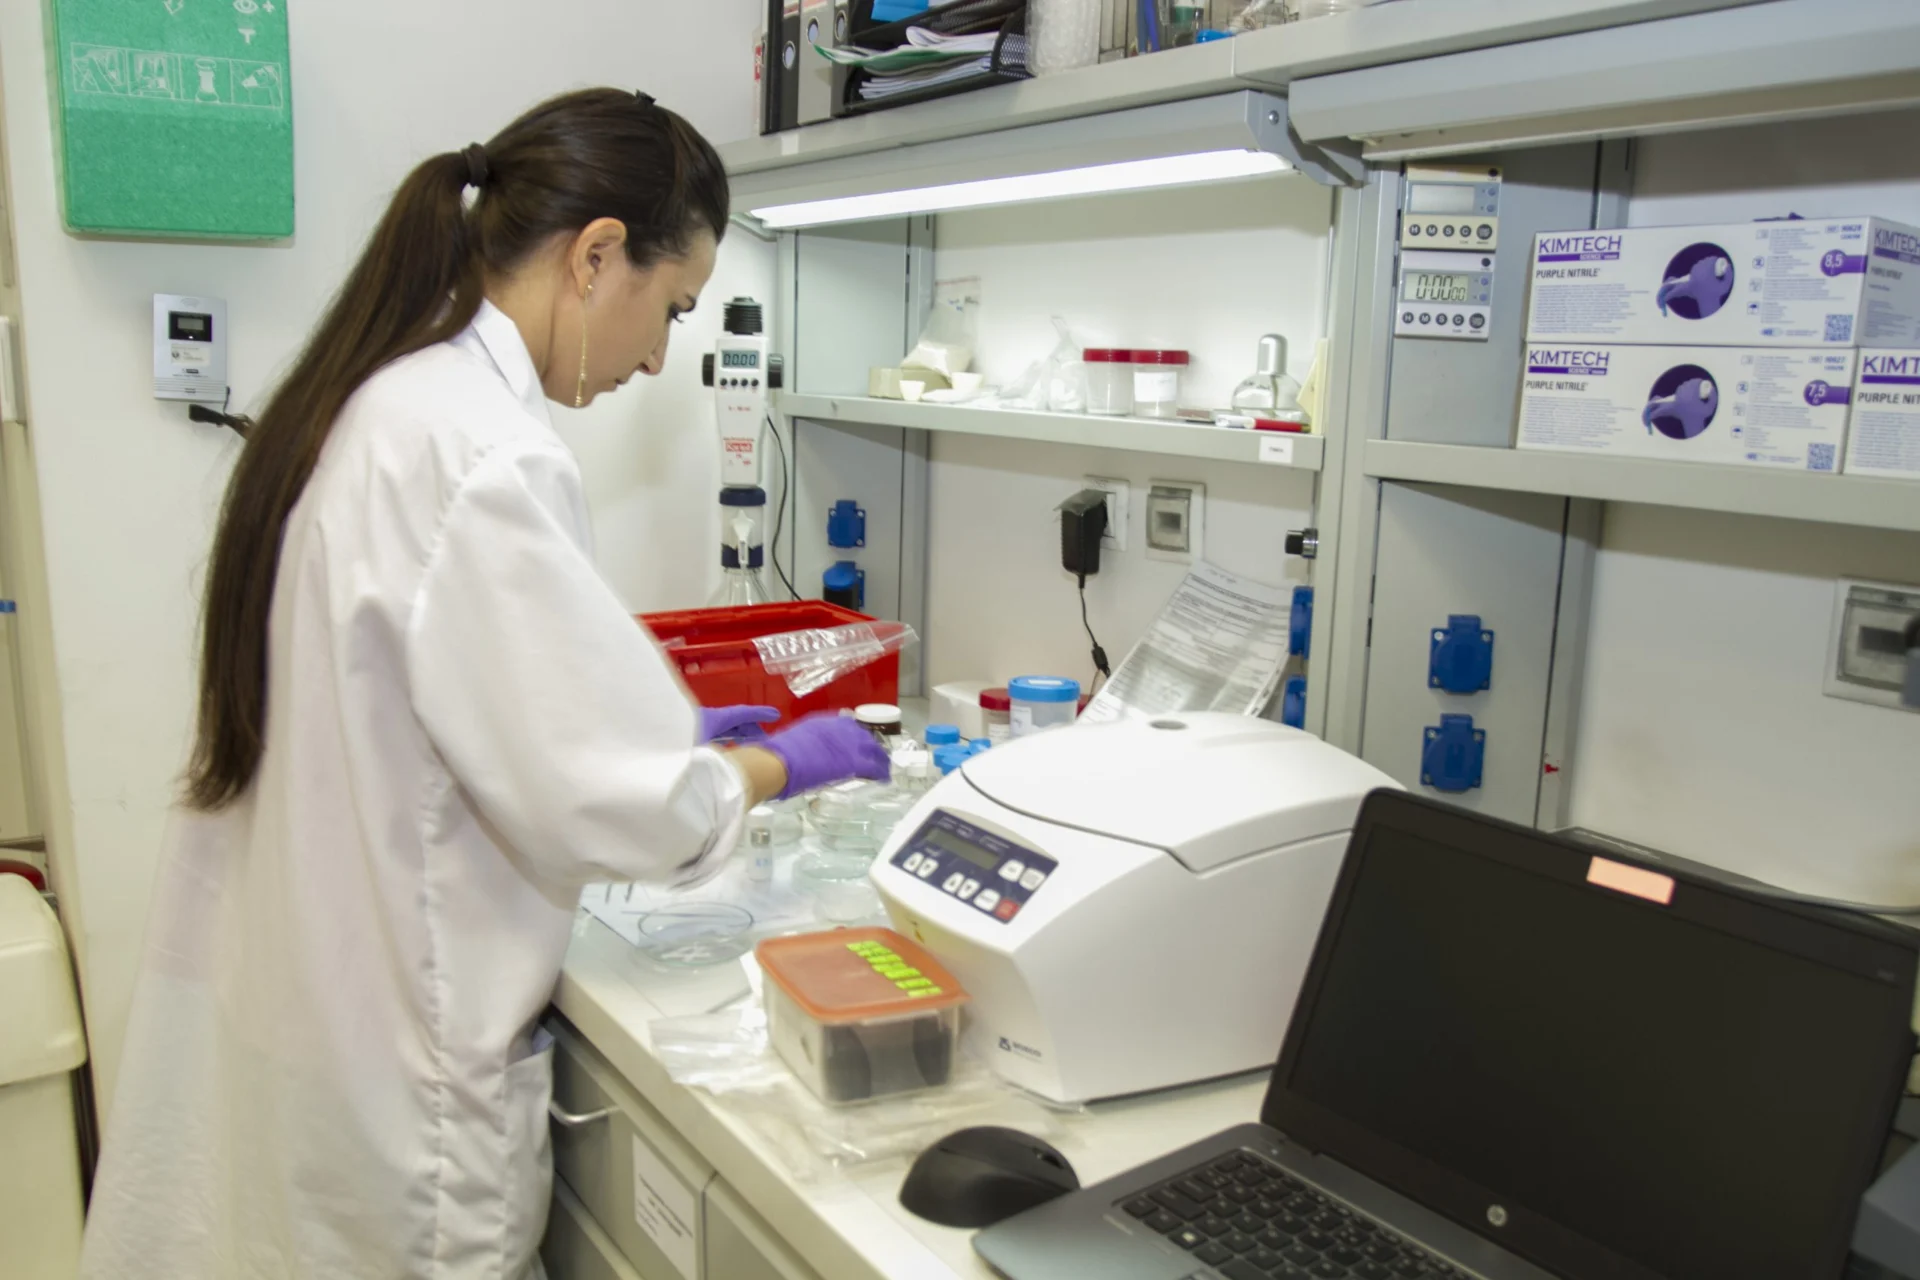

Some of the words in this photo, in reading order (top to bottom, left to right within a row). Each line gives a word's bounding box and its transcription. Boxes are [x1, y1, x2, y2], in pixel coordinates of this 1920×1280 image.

[1538, 235, 1622, 253] KIMTECH
[1536, 267, 1565, 279] PURPLE
[1528, 350, 1610, 367] KIMTECH
[1863, 355, 1920, 375] KIMT
[1525, 380, 1554, 390] PURPLE
[1858, 392, 1900, 405] PURPLE
